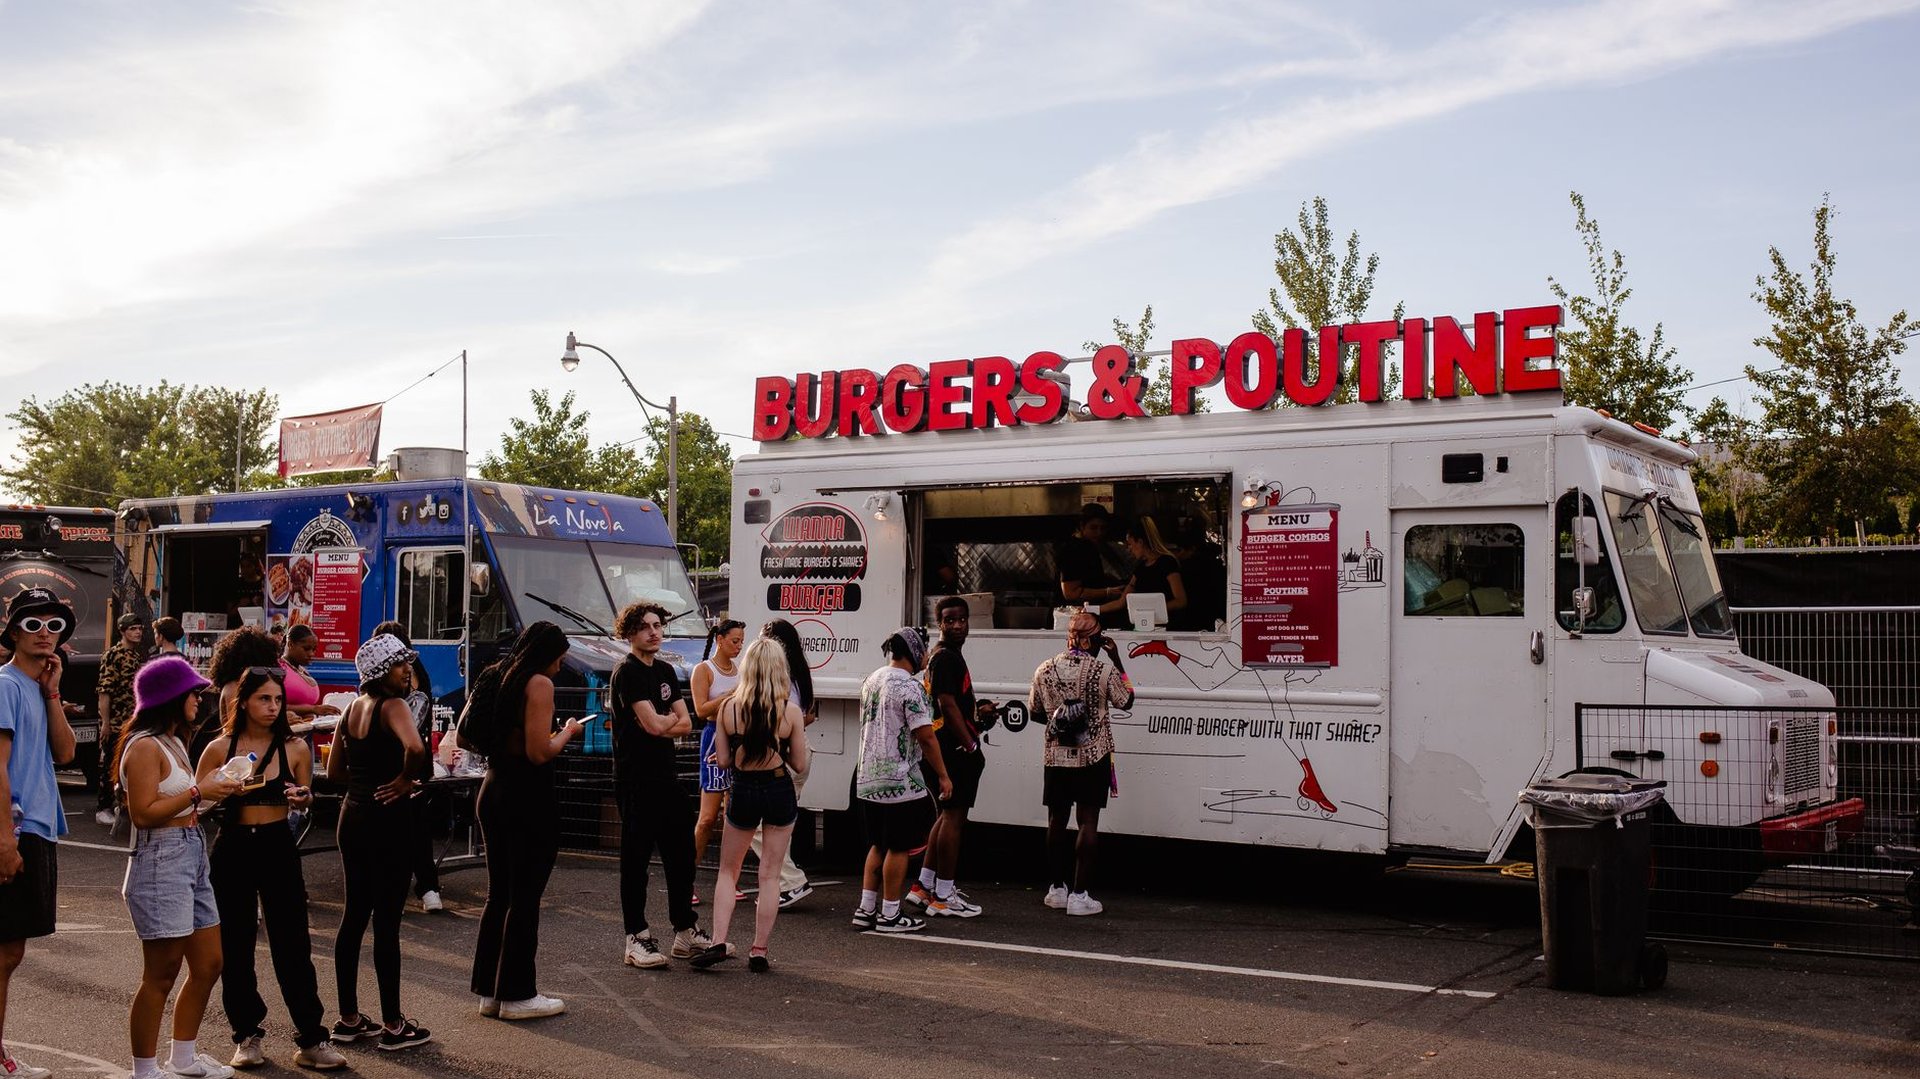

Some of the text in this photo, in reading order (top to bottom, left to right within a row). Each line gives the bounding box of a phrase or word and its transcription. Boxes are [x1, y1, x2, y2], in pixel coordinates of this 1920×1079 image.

[752, 304, 1564, 443] BURGERS & POUTINE
[534, 504, 560, 526] La
[1268, 514, 1310, 526] MENU
[59, 527, 111, 541] TRUCK
[783, 515, 846, 541] WANNA
[1247, 532, 1330, 544] BURGER COMBOS
[328, 553, 350, 562] MENU
[763, 556, 864, 568] FRESH MADE BURGERS & SHAKES
[37, 568, 54, 577] FOOD
[780, 585, 845, 610] BURGER
[1263, 586, 1309, 596] POUTINES
[800, 637, 859, 653] URGERTO.COM
[1266, 654, 1305, 664] WATER
[1148, 715, 1193, 734] WANNA
[1196, 717, 1246, 737] BURGER
[1249, 719, 1283, 739] WITH
[1289, 720, 1322, 741] THAT
